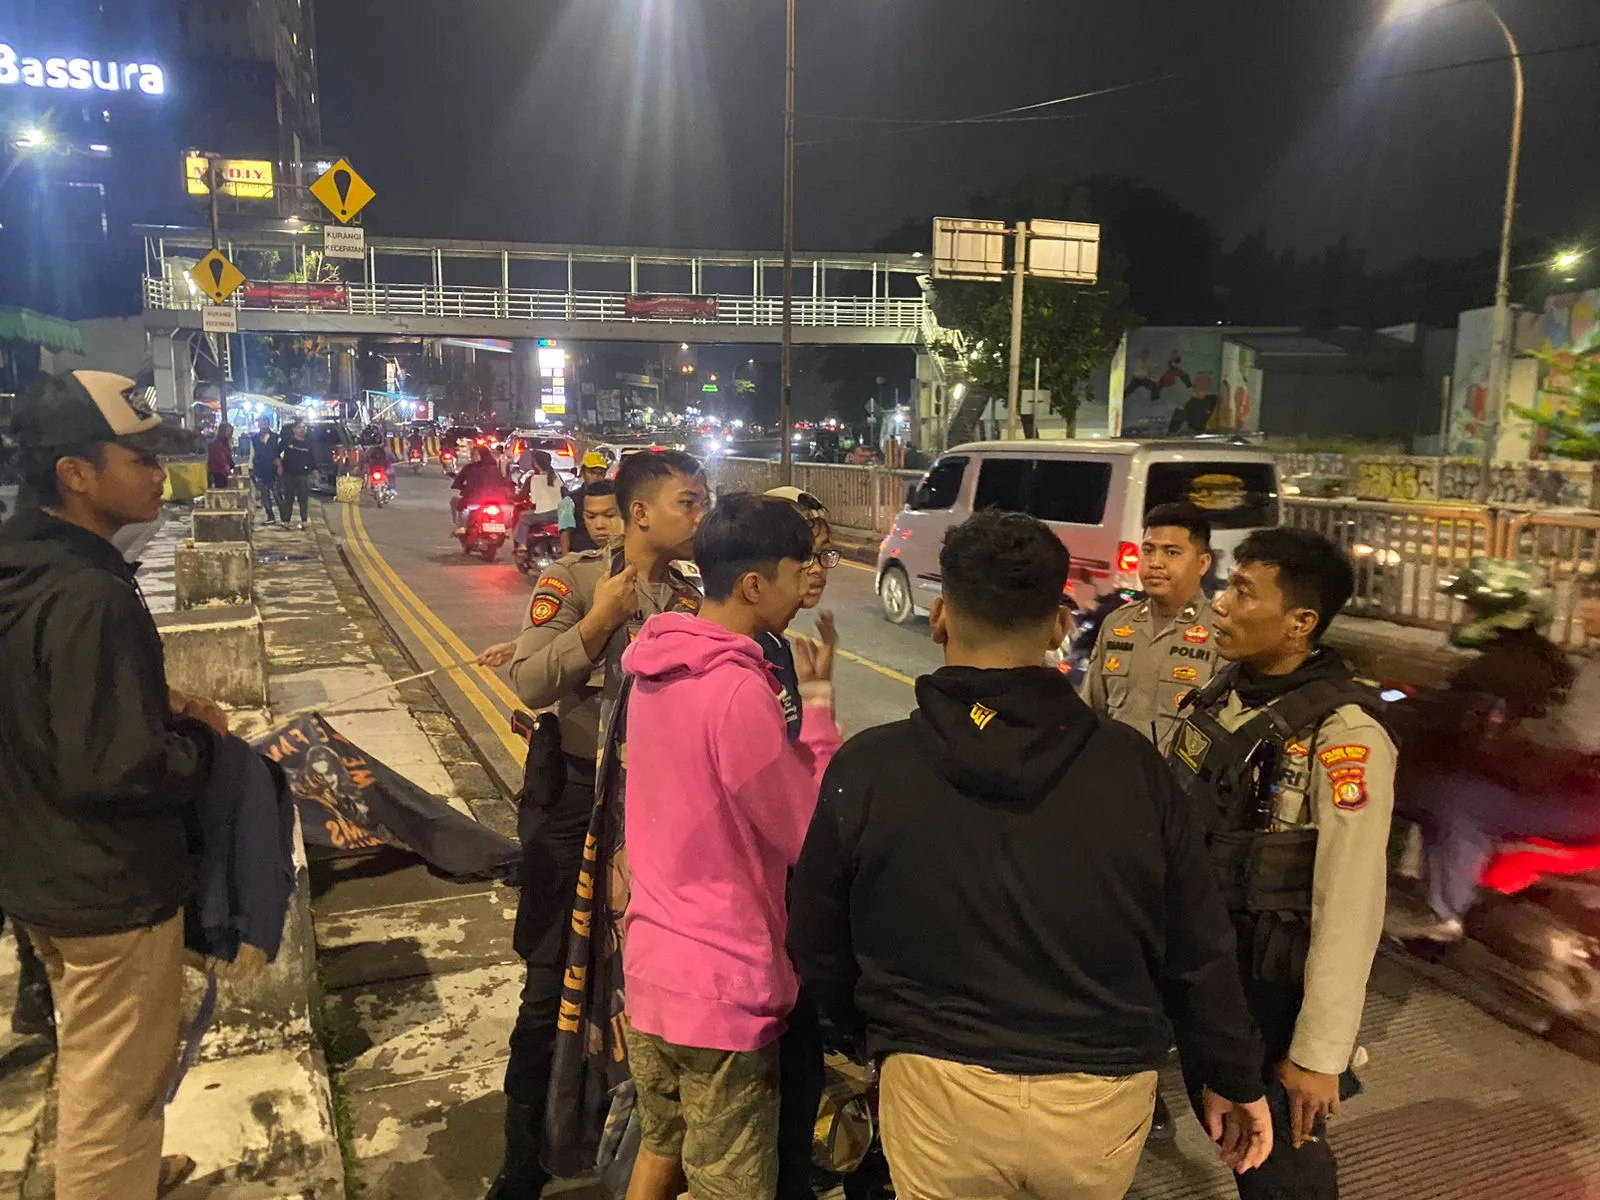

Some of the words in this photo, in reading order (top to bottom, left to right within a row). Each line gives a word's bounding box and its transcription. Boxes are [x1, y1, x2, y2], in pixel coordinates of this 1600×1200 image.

[0, 43, 164, 95] Bassura
[327, 232, 361, 240] KURANGI
[326, 244, 364, 253] KECEPATAN
[1169, 646, 1211, 661] POLRI
